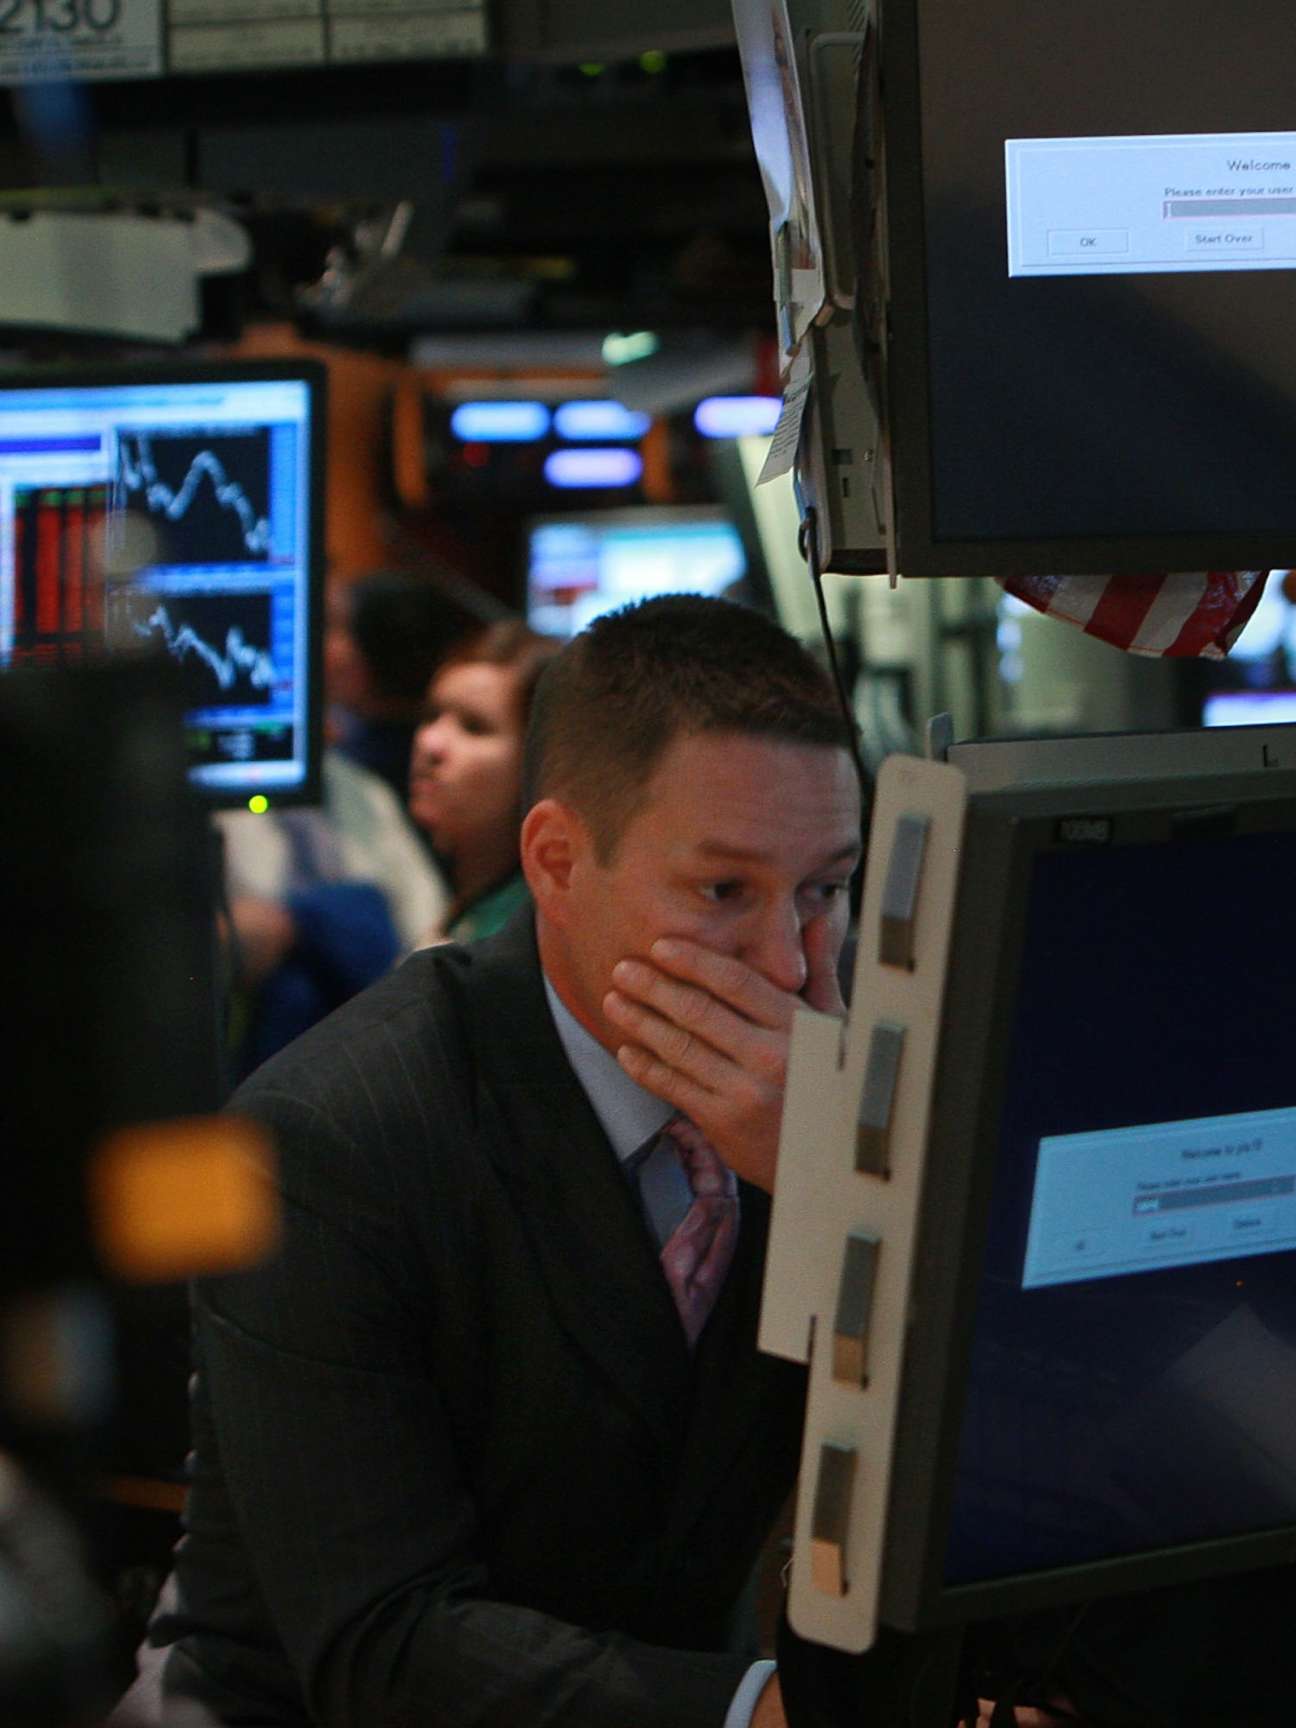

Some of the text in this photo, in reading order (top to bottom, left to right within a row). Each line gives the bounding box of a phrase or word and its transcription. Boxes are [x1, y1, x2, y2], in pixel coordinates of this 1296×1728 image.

[1227, 158, 1292, 172] Welcome
[1164, 186, 1201, 197] Please
[1205, 186, 1236, 196] enter
[1239, 187, 1265, 197] your
[1267, 186, 1293, 194] user
[1079, 236, 1097, 248] OK
[1194, 233, 1253, 245] Start Over
